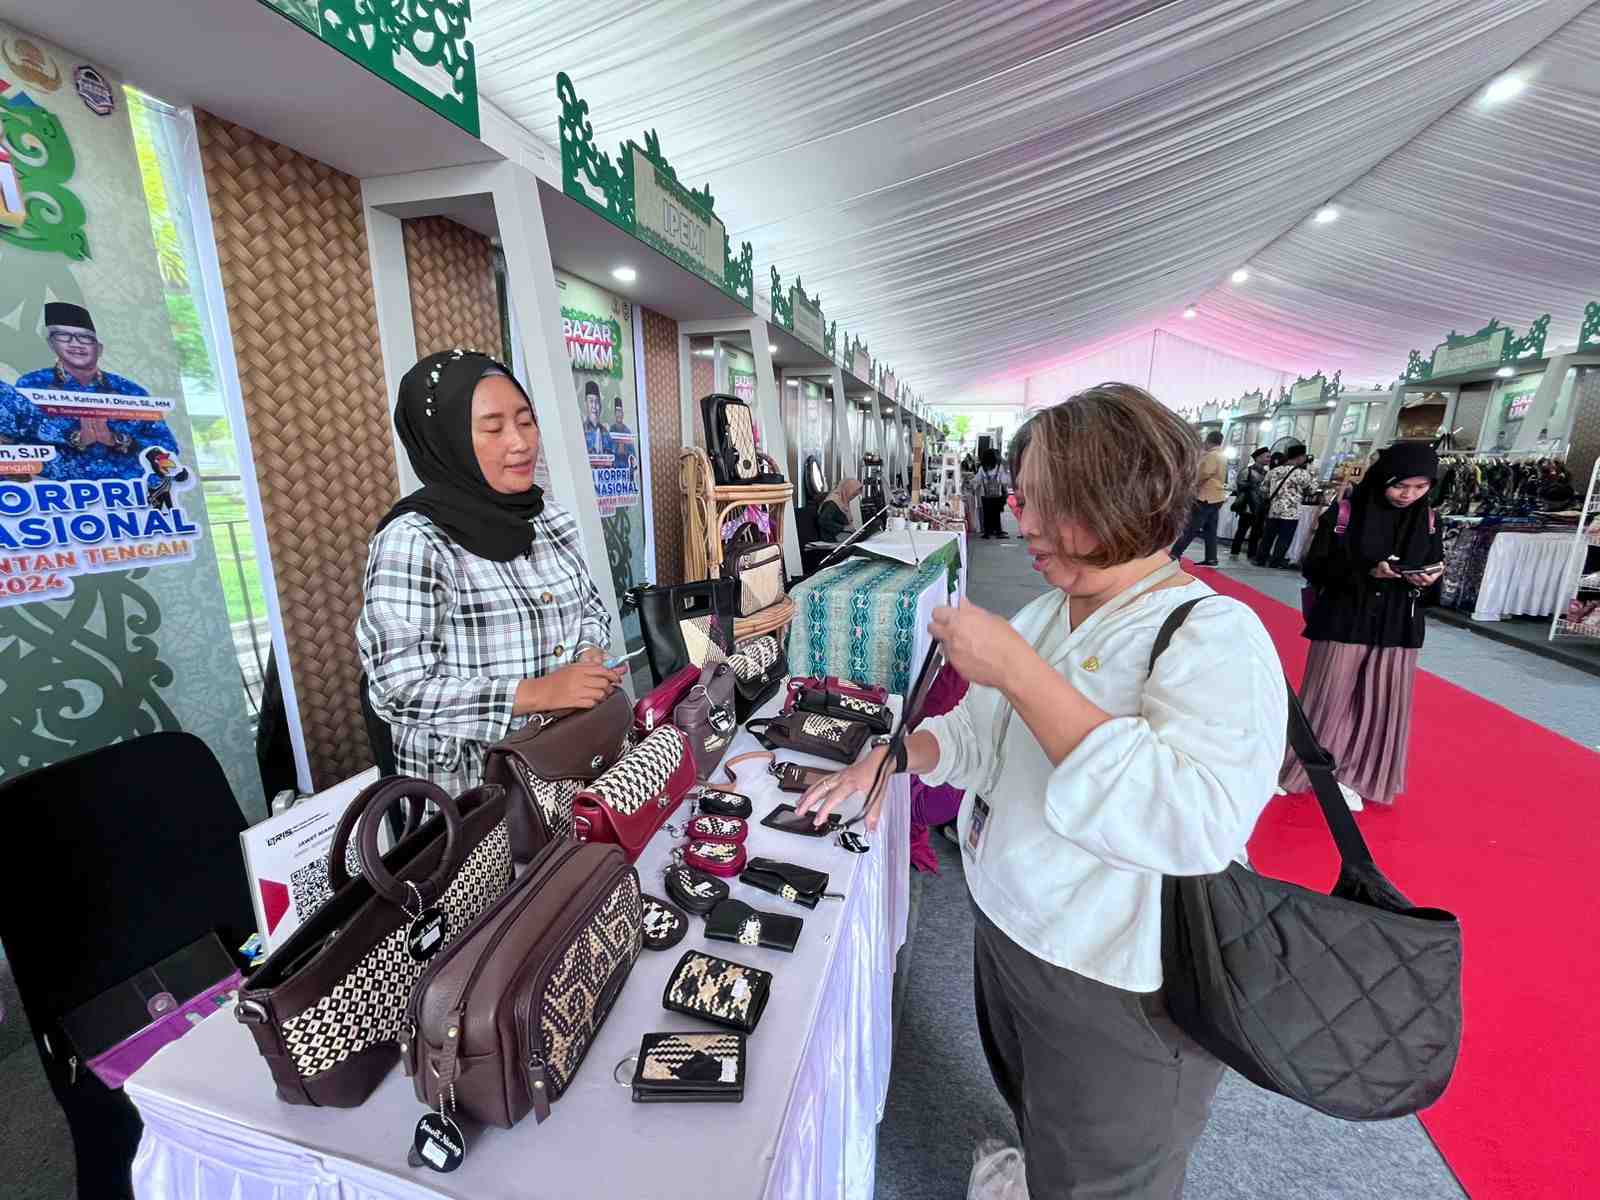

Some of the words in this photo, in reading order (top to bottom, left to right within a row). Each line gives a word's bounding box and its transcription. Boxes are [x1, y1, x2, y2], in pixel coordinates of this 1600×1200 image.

[562, 317, 612, 343] BAZAR
[32, 392, 48, 401] Dr.
[48, 393, 60, 402] H.
[18, 447, 50, 459] S.IP
[82, 539, 189, 566] TENGAH
